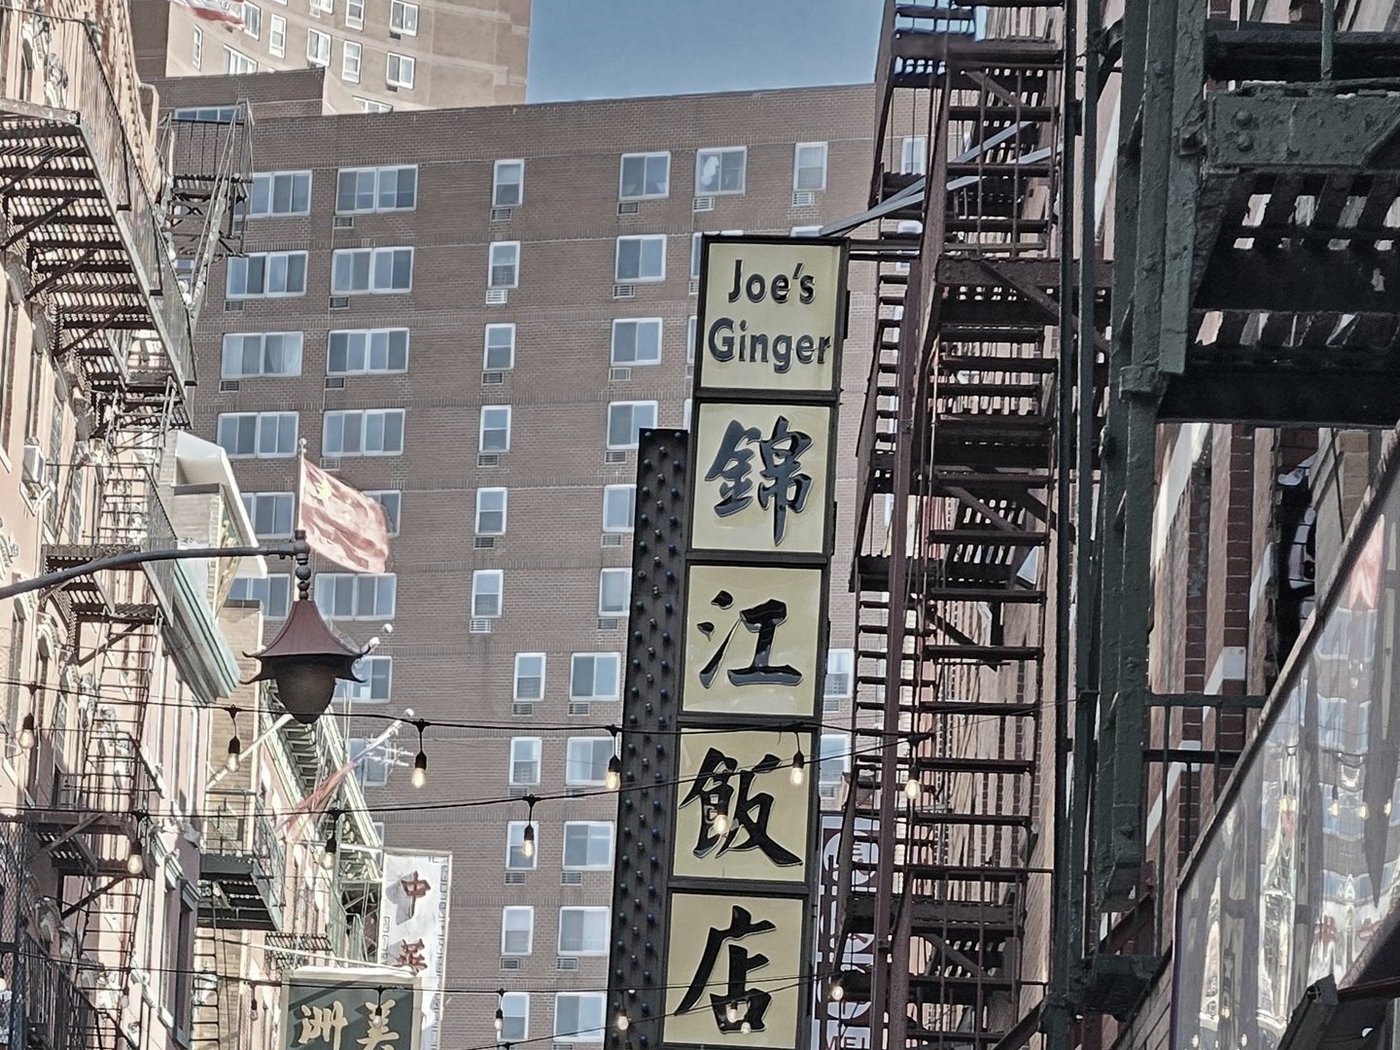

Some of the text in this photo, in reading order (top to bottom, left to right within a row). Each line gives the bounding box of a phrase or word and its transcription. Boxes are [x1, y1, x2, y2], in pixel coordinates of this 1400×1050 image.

[728, 259, 817, 305] Joe's
[707, 317, 831, 373] Ginger
[674, 414, 814, 1034] 錦江飯店
